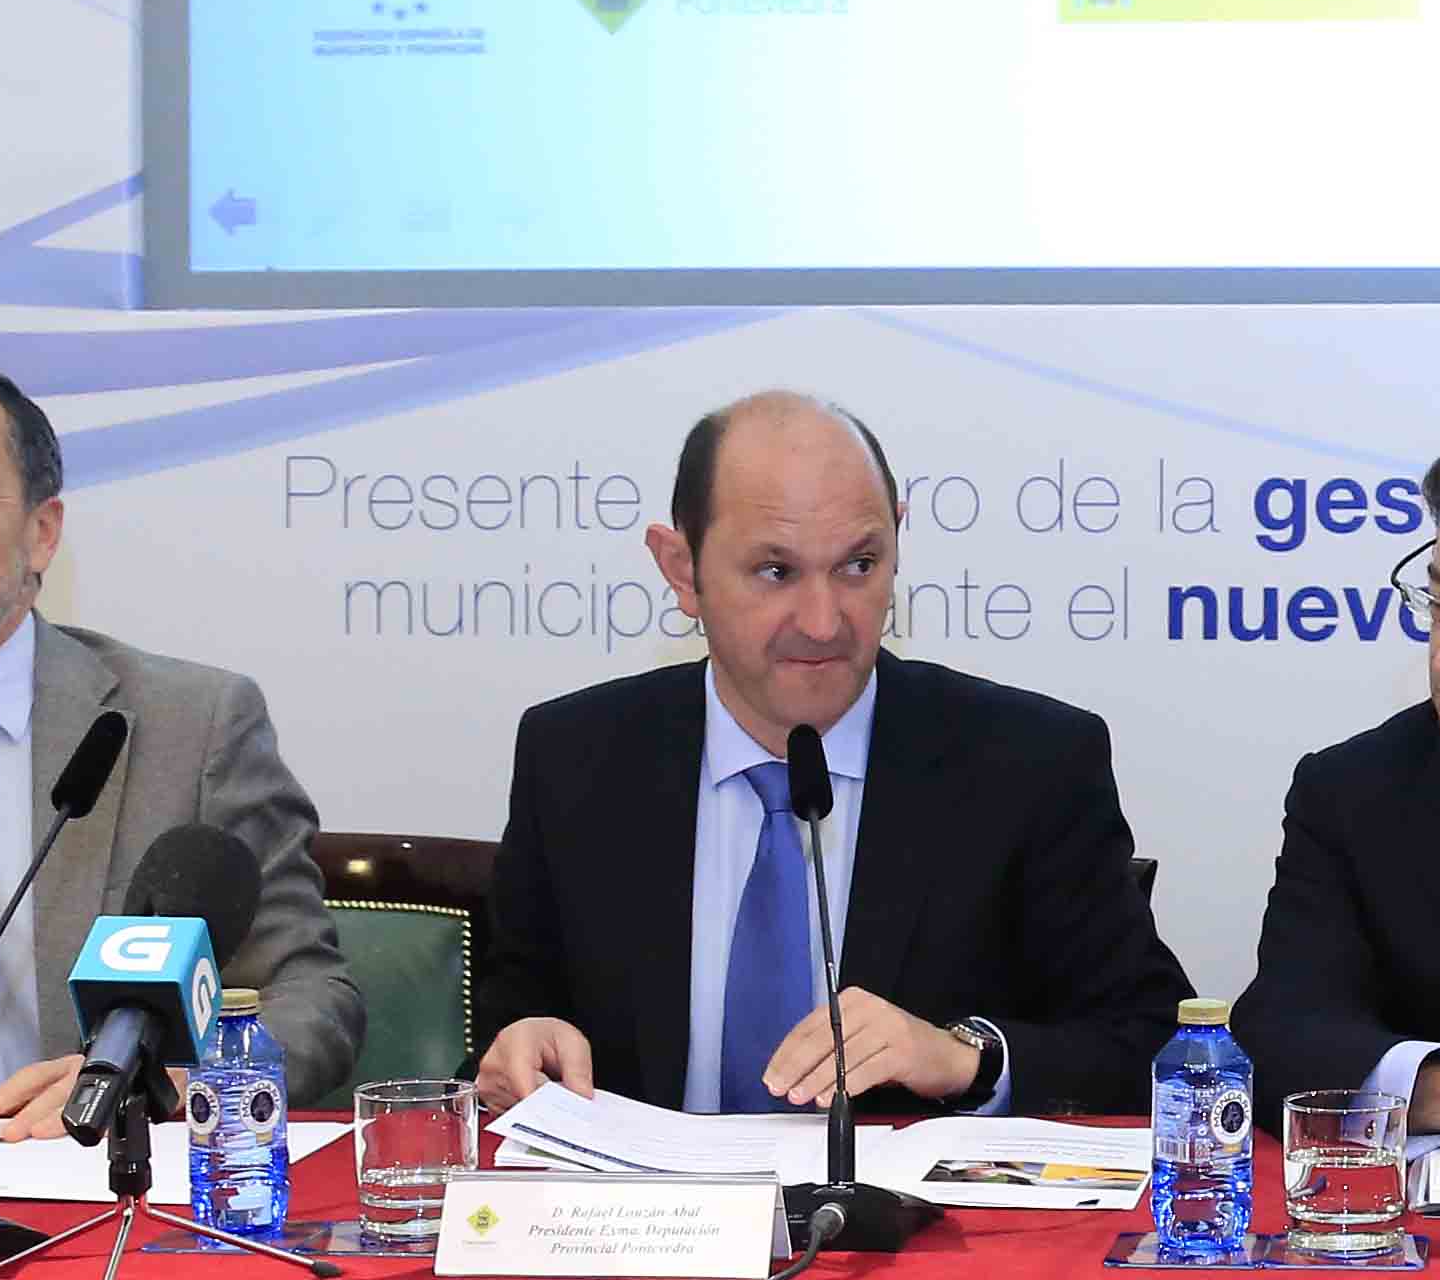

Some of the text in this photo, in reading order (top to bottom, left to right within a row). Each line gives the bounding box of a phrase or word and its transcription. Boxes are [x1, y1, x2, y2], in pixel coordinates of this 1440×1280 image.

[284, 455, 642, 531] Presente
[1015, 457, 1121, 534] de
[1159, 457, 1222, 534] la
[343, 562, 706, 654] municipa
[1067, 565, 1130, 641] el
[1212, 1091, 1251, 1128] MONDARIZ
[528, 1224, 594, 1237] Presidente
[550, 1241, 617, 1255] Provincial
